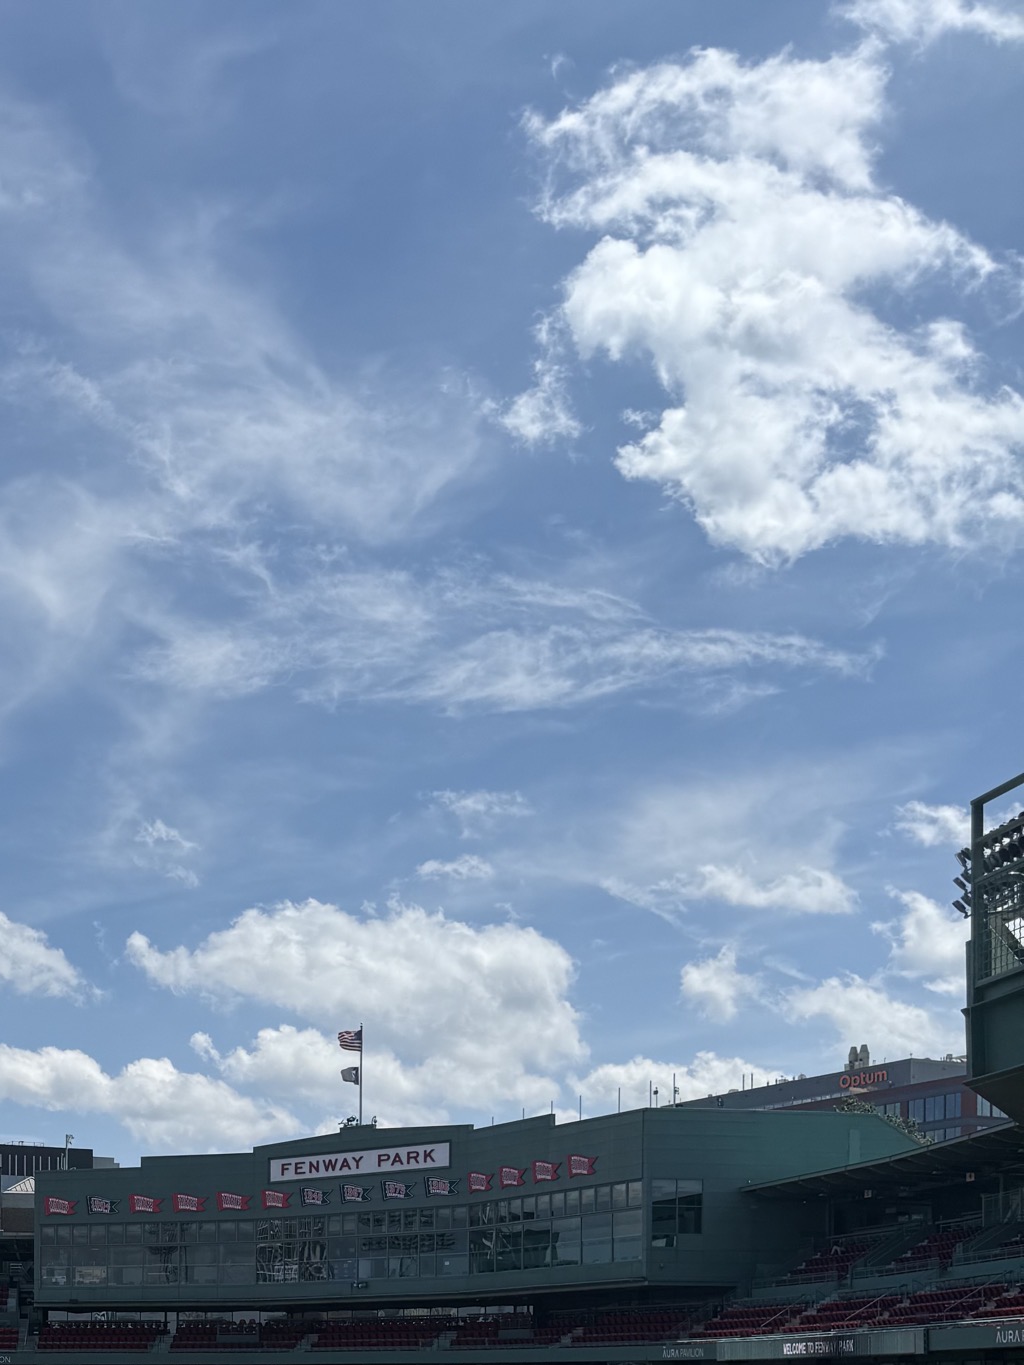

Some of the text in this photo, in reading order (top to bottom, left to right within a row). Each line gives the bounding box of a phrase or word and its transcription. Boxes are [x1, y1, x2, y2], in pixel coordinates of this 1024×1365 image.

[839, 1070, 888, 1088] Optum
[280, 1149, 436, 1176] FENWAY PARK
[783, 1342, 806, 1355] WELCOME
